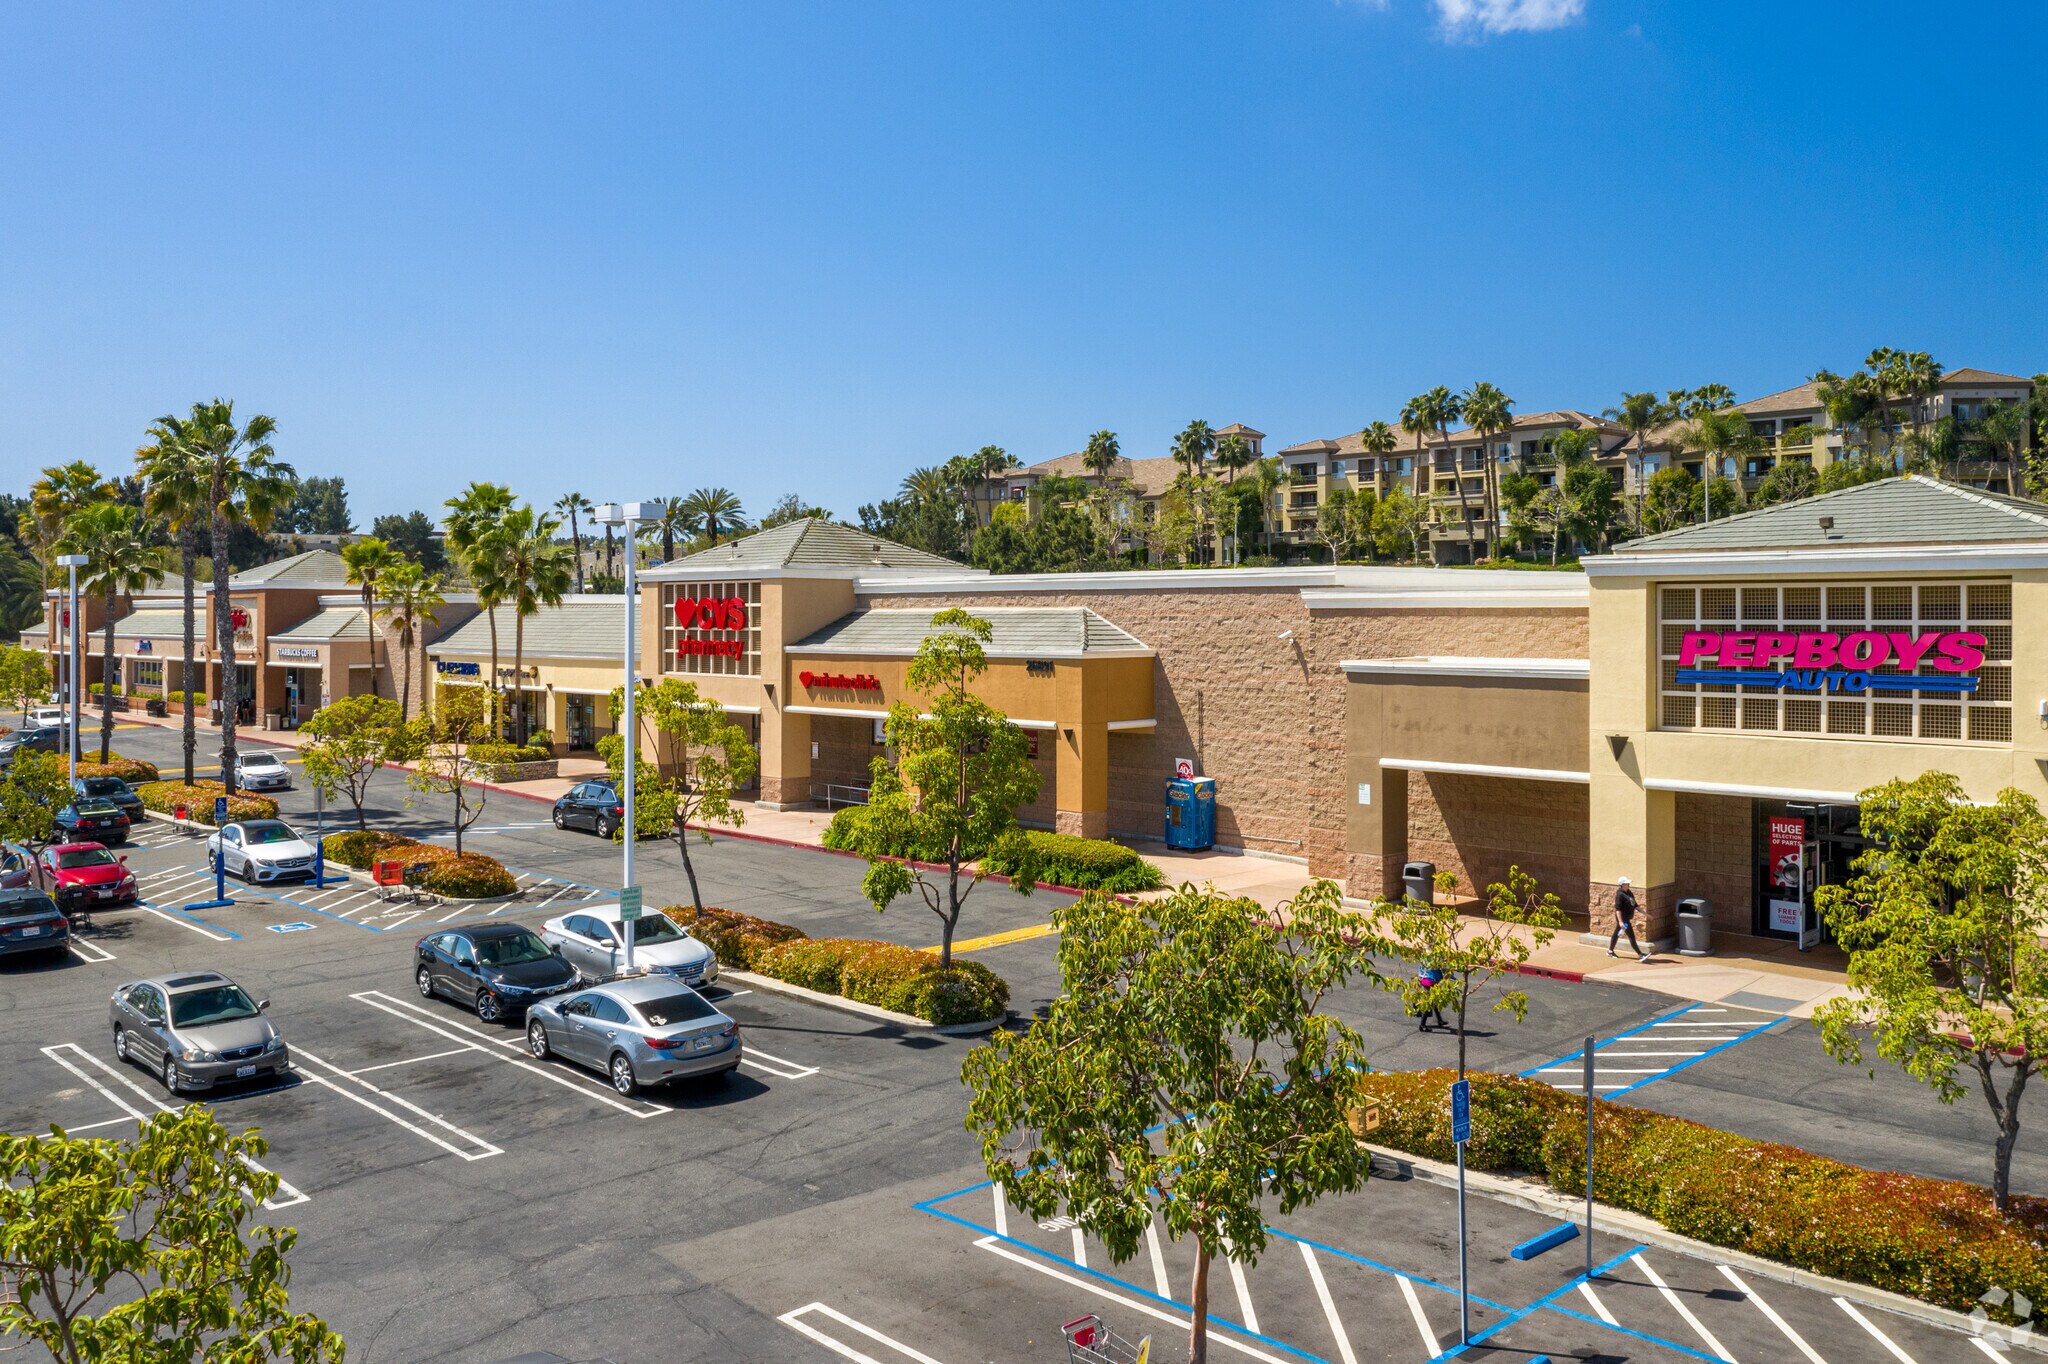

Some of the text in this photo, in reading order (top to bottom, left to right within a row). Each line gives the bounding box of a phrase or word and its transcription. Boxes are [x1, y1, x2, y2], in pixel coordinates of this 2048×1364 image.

[696, 597, 746, 631] CVS
[276, 648, 318, 657] STARBUCKS COFFEE
[678, 635, 744, 661] pharmacy
[1775, 670, 1872, 692] AUTO
[1772, 823, 1802, 835] HUGE
[1772, 833, 1802, 841] SELECTION
[1781, 839, 1801, 847] PARTS
[1777, 907, 1798, 916] FREE
